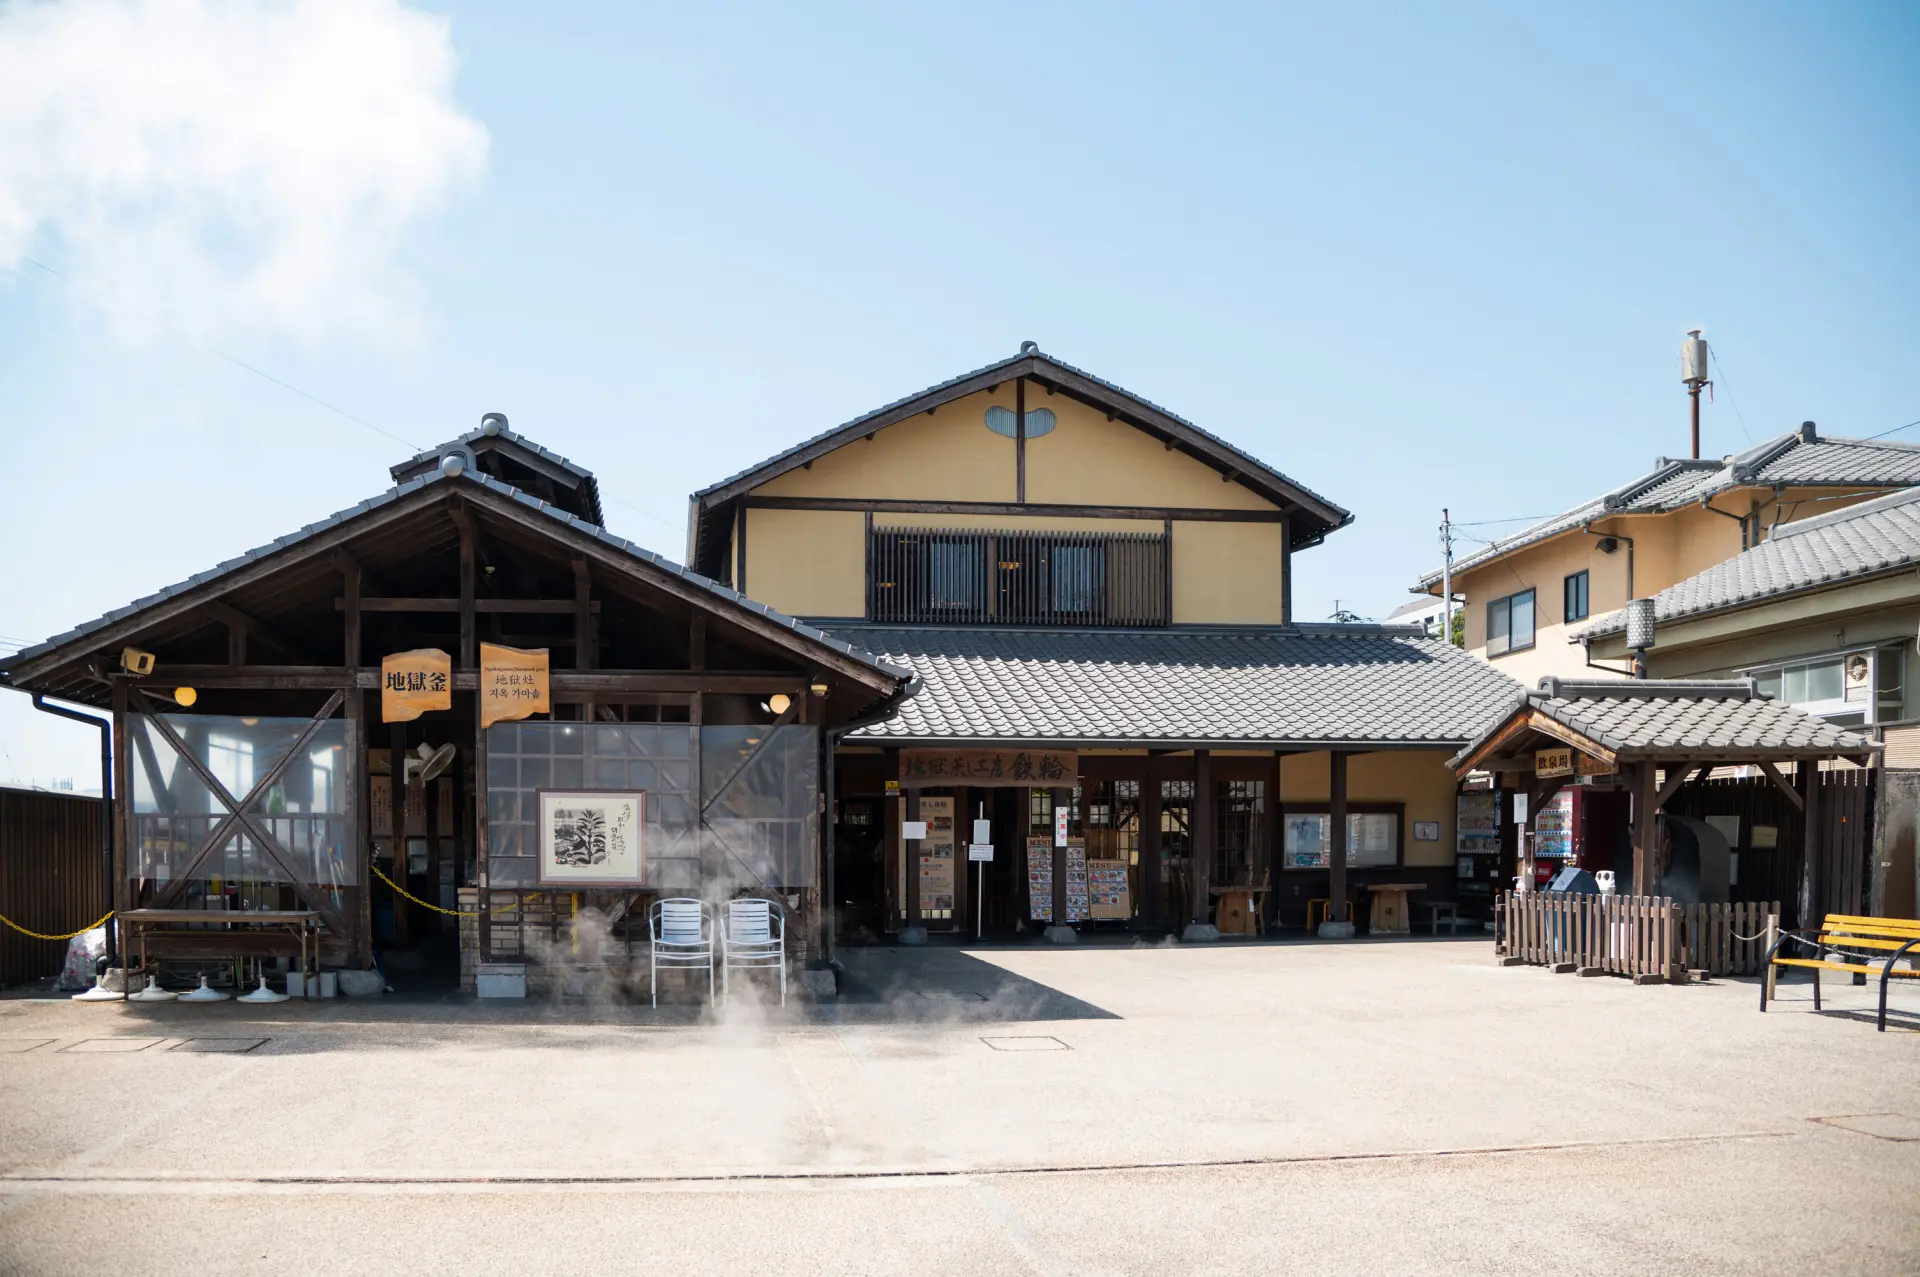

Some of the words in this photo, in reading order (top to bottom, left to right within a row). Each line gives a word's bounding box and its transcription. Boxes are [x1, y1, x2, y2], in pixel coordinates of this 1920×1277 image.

[385, 671, 447, 692] 地獄釜
[489, 688, 509, 699] 지옥
[511, 688, 541, 699] 가마솥
[905, 754, 1004, 778] 地獄蒸し工房
[1008, 752, 1072, 781] 鉄輪
